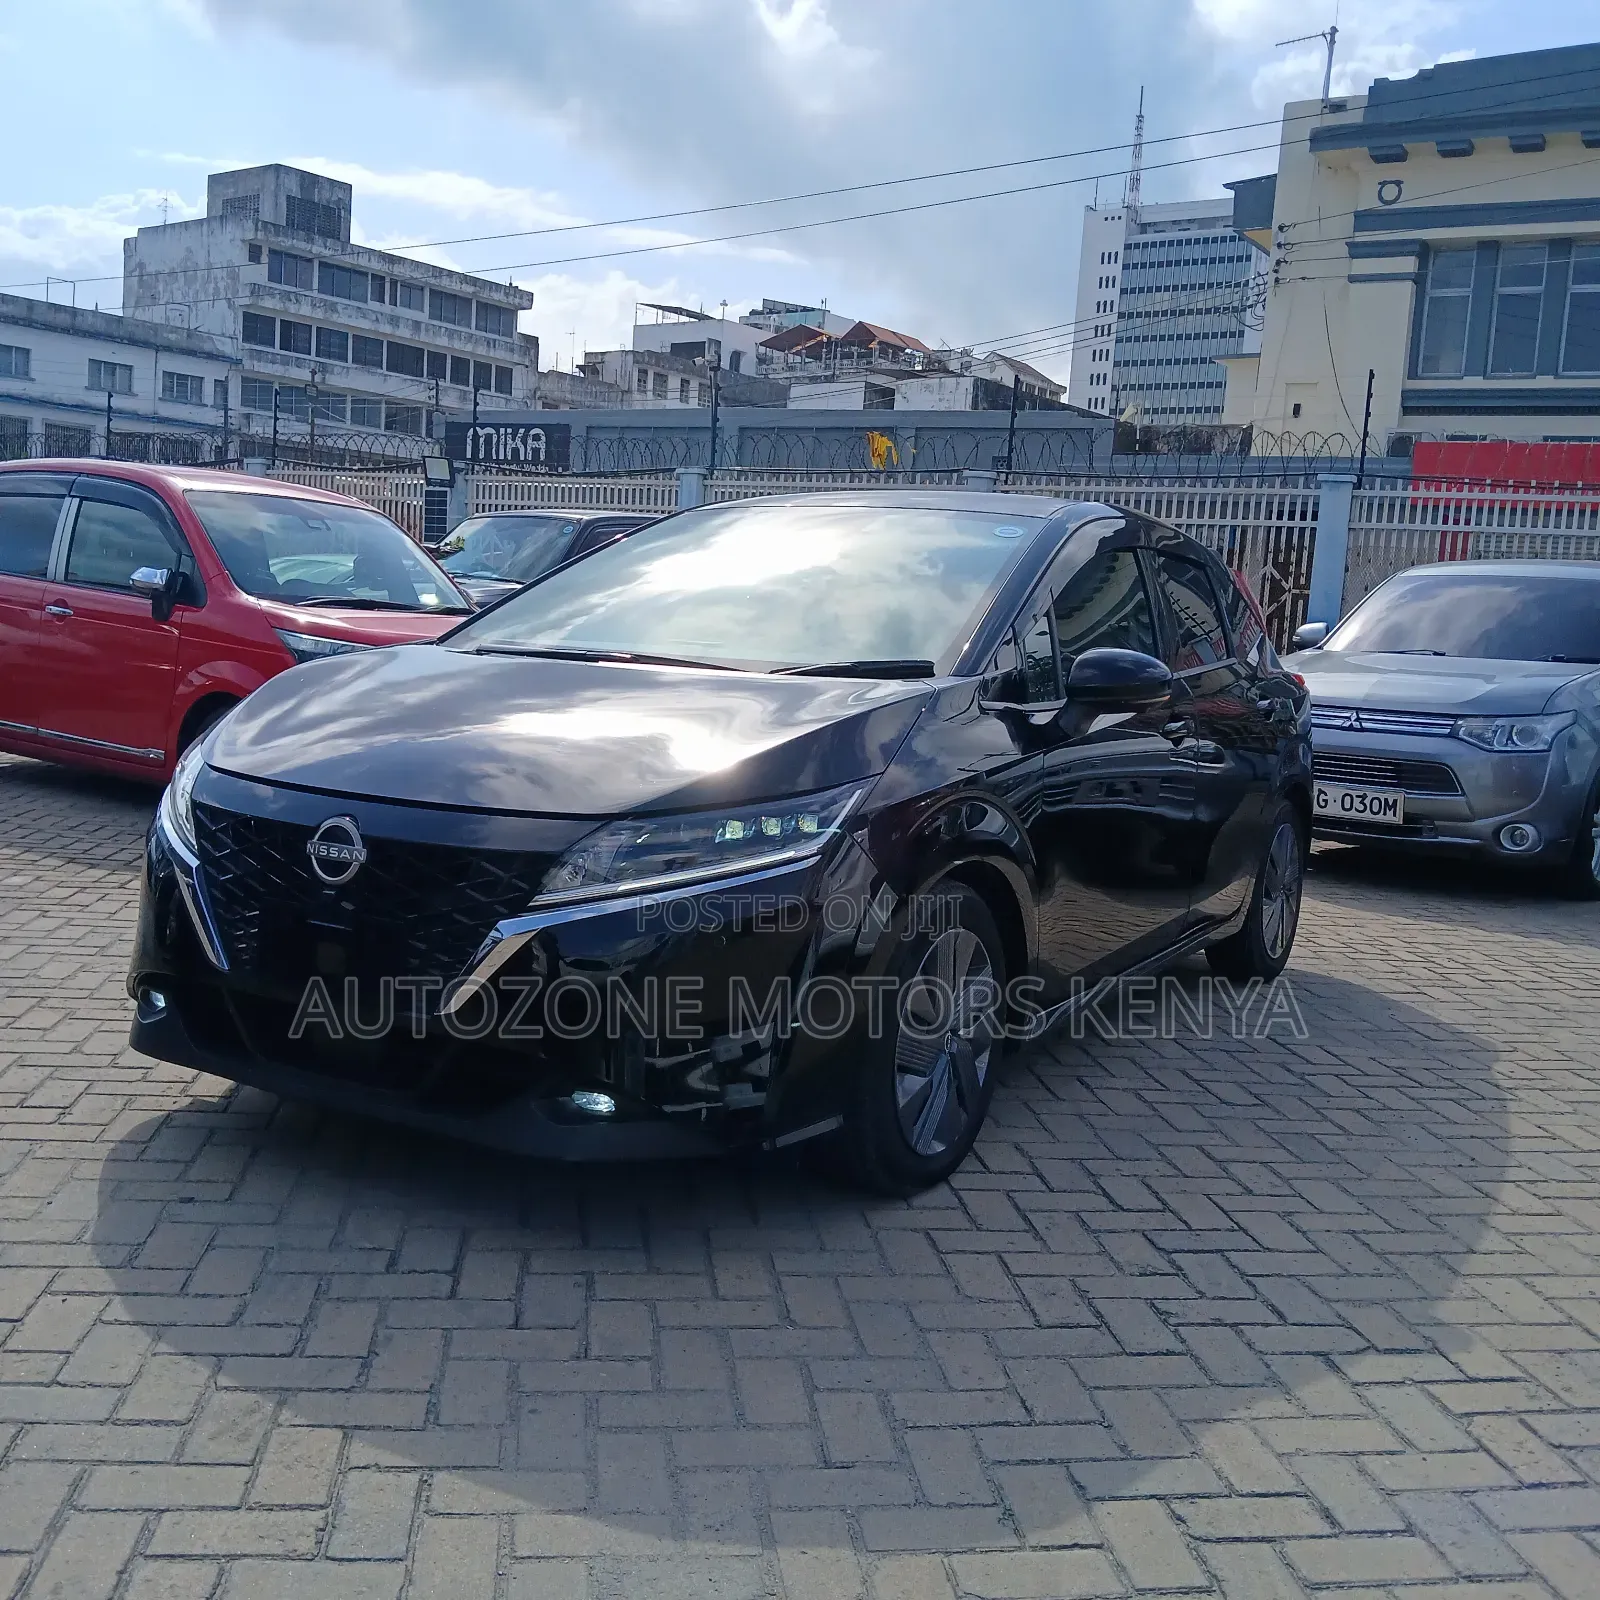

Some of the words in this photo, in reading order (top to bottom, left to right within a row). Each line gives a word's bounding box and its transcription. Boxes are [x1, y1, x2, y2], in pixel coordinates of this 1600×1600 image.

[466, 427, 546, 461] MIKA
[1341, 792, 1399, 818] 030M
[306, 843, 365, 861] NISSAN
